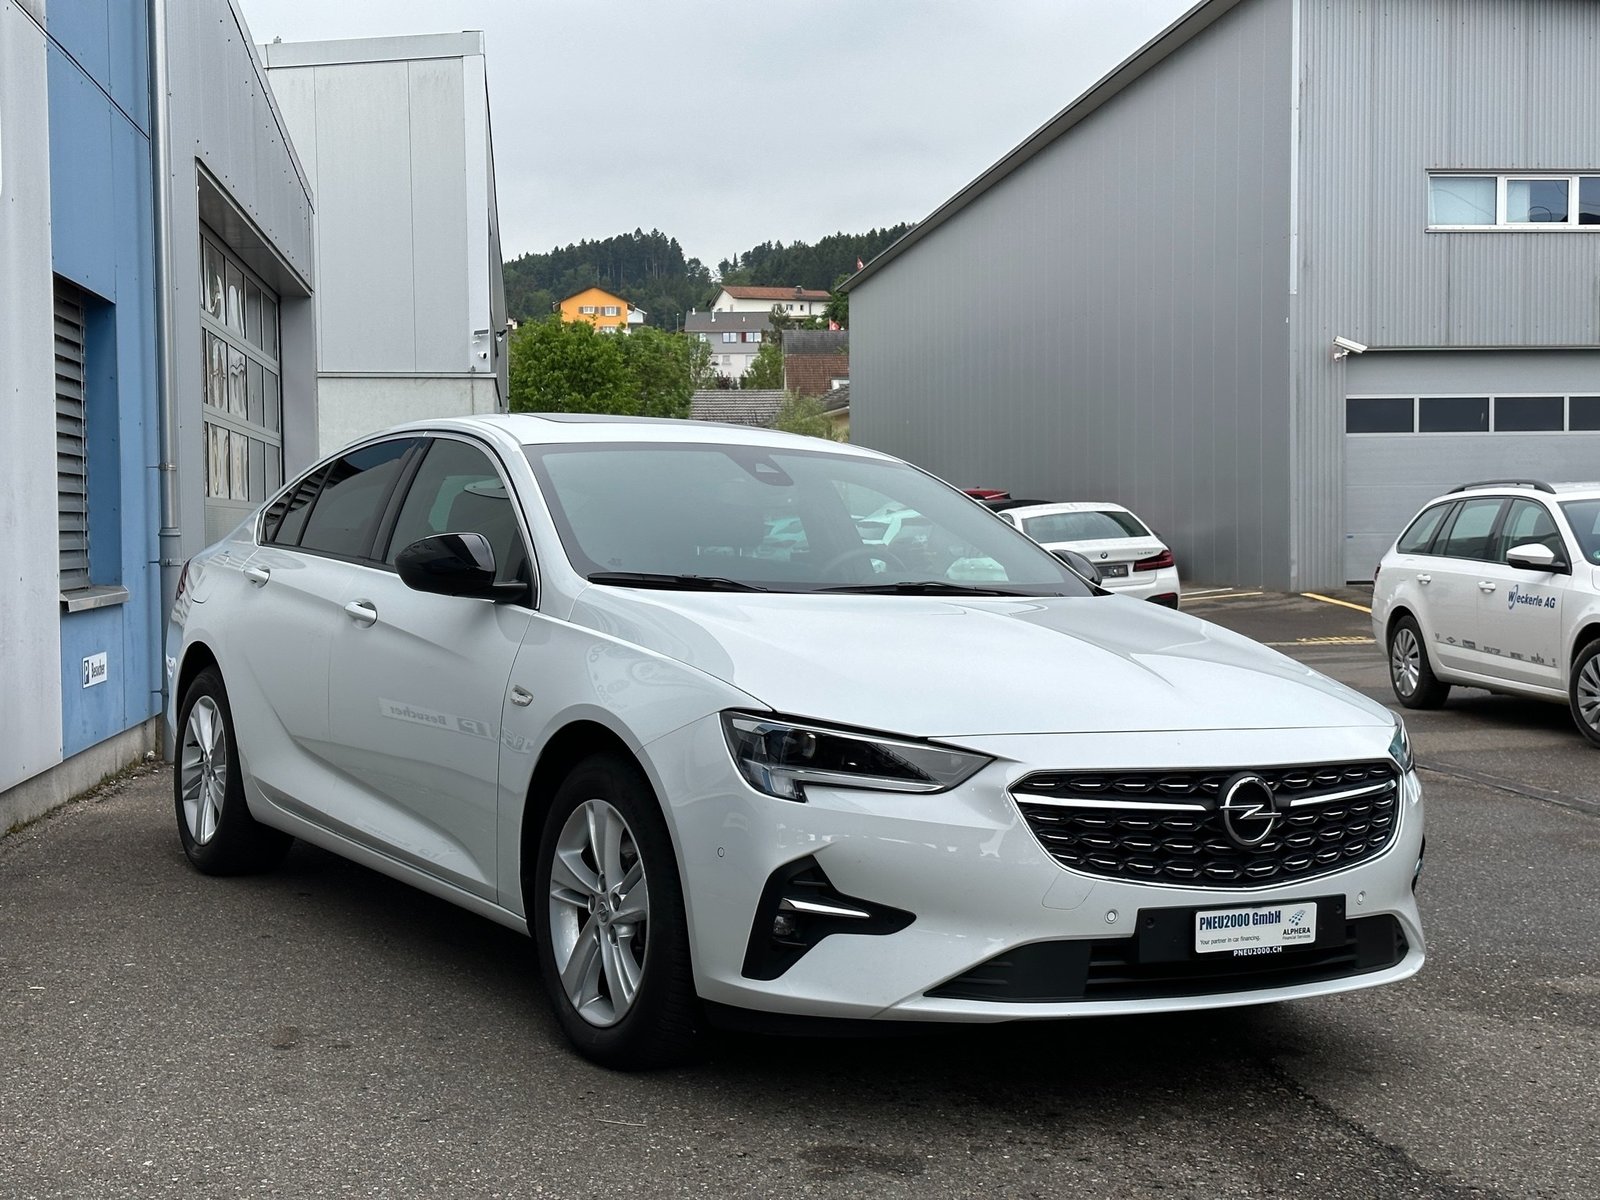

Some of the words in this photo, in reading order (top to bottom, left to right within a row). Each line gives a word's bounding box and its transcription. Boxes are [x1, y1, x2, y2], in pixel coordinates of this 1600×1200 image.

[1508, 589, 1542, 607] Weckerle
[1544, 597, 1556, 608] AG
[1200, 913, 1250, 931] PNEU2000
[1252, 910, 1281, 925] GmbH
[1282, 927, 1311, 935] ALPHERA
[1233, 946, 1282, 957] PNEU2000.CH
